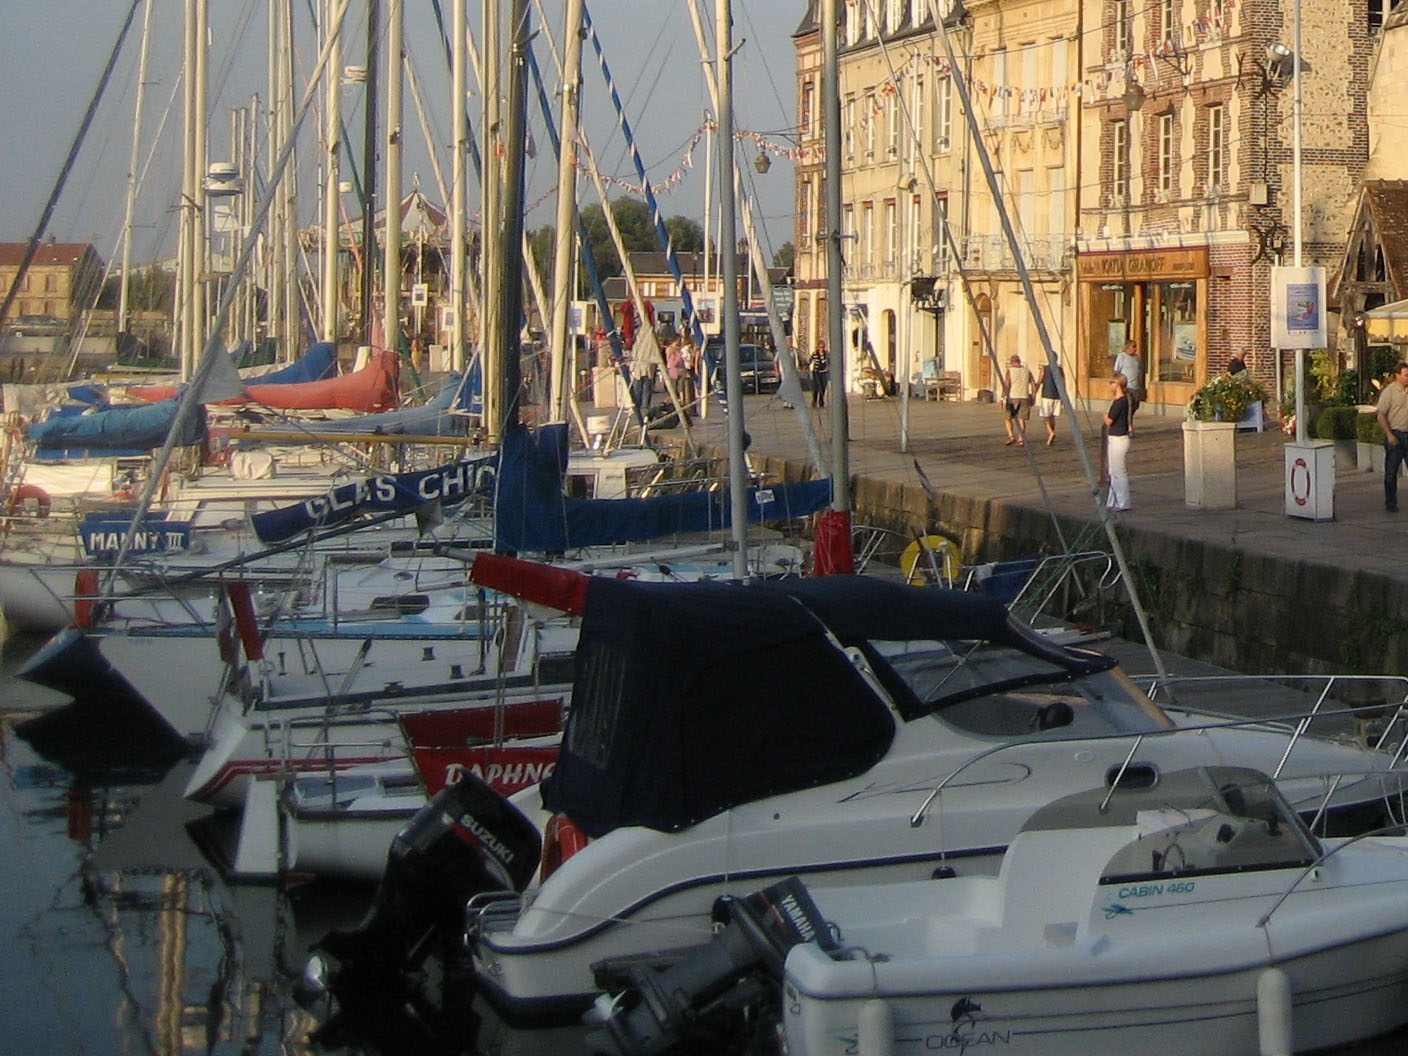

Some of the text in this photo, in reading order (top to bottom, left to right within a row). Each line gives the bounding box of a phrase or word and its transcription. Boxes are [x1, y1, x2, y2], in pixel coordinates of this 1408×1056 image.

[461, 814, 514, 863] SUZUKI
[1119, 882, 1195, 899] CABIN 460
[782, 894, 815, 941] YAMAHA
